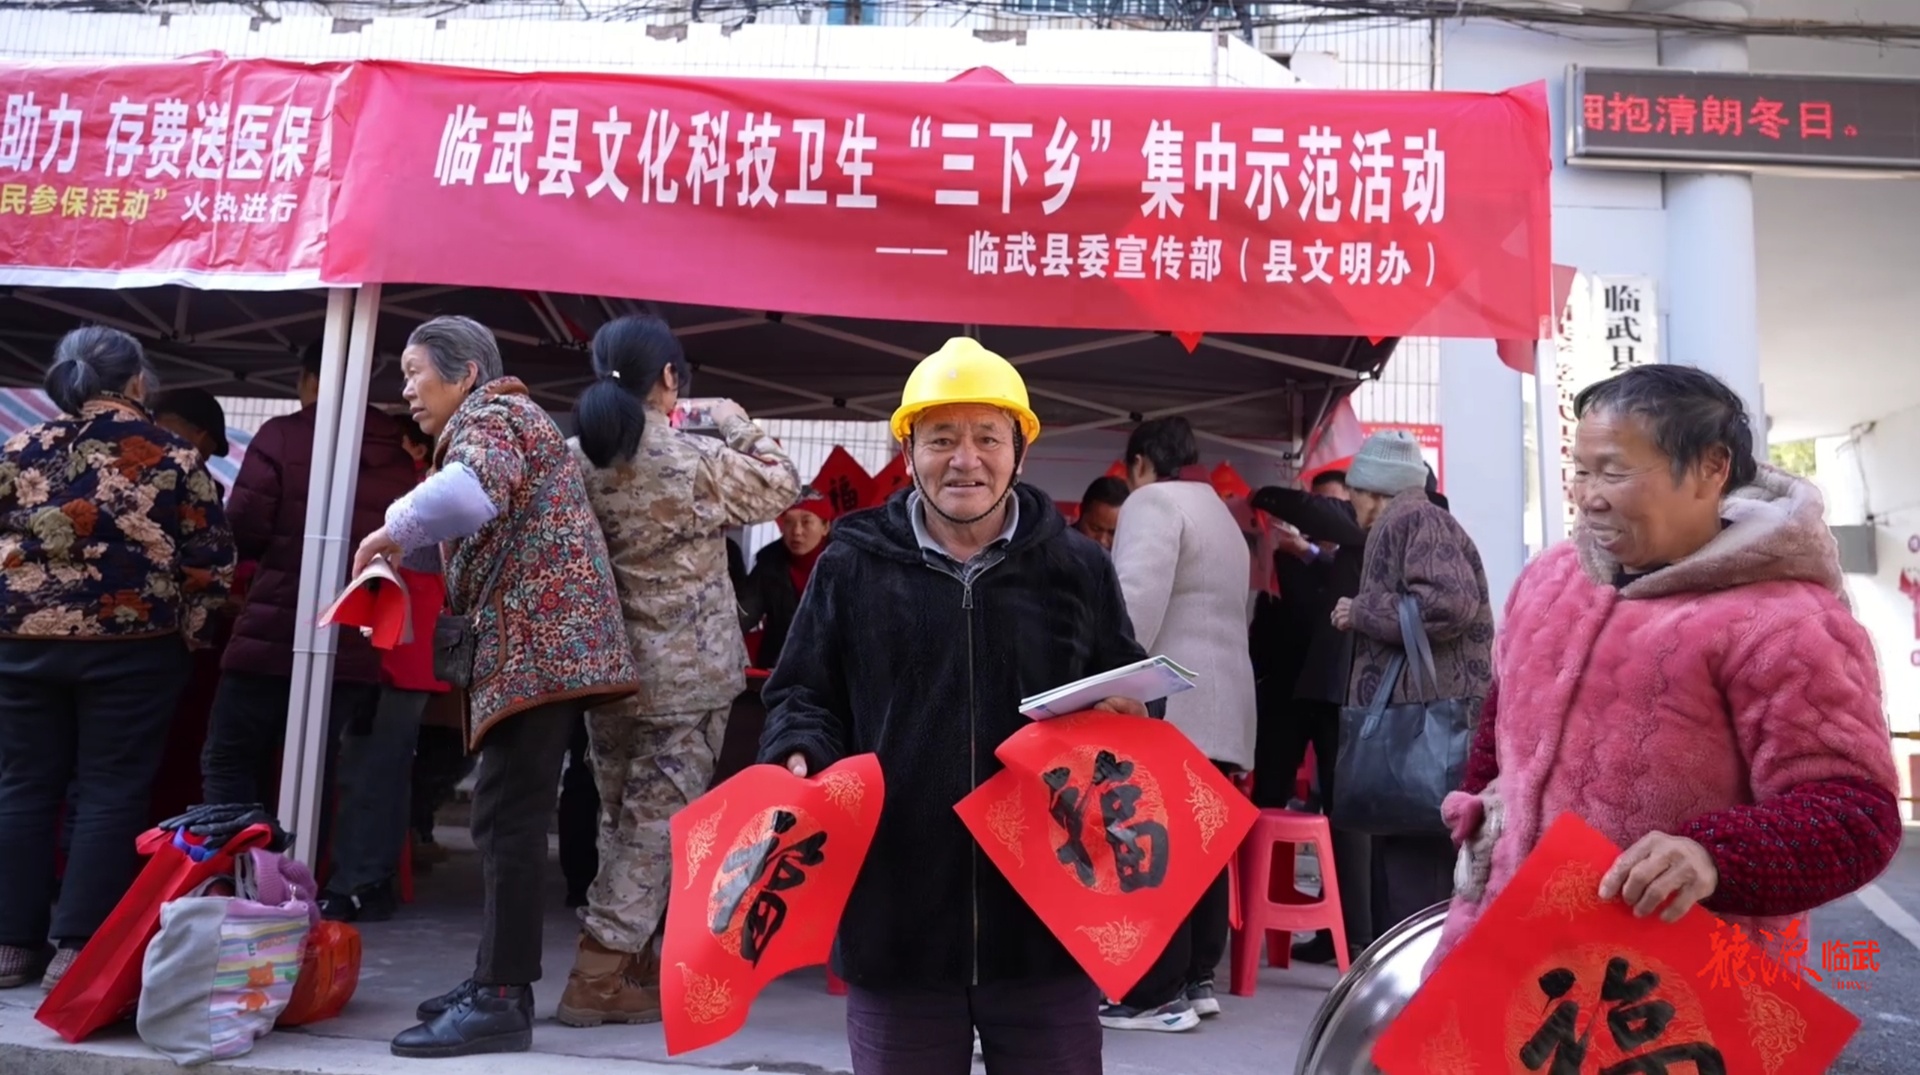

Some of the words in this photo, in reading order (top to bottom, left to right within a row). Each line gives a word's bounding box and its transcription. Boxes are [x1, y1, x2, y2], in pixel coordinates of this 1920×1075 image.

[105, 95, 313, 182] 存费送医保
[181, 191, 298, 223] 火热进行
[1605, 284, 1642, 371] 临武县
[1042, 750, 1169, 893] 福
[708, 809, 828, 968] 福
